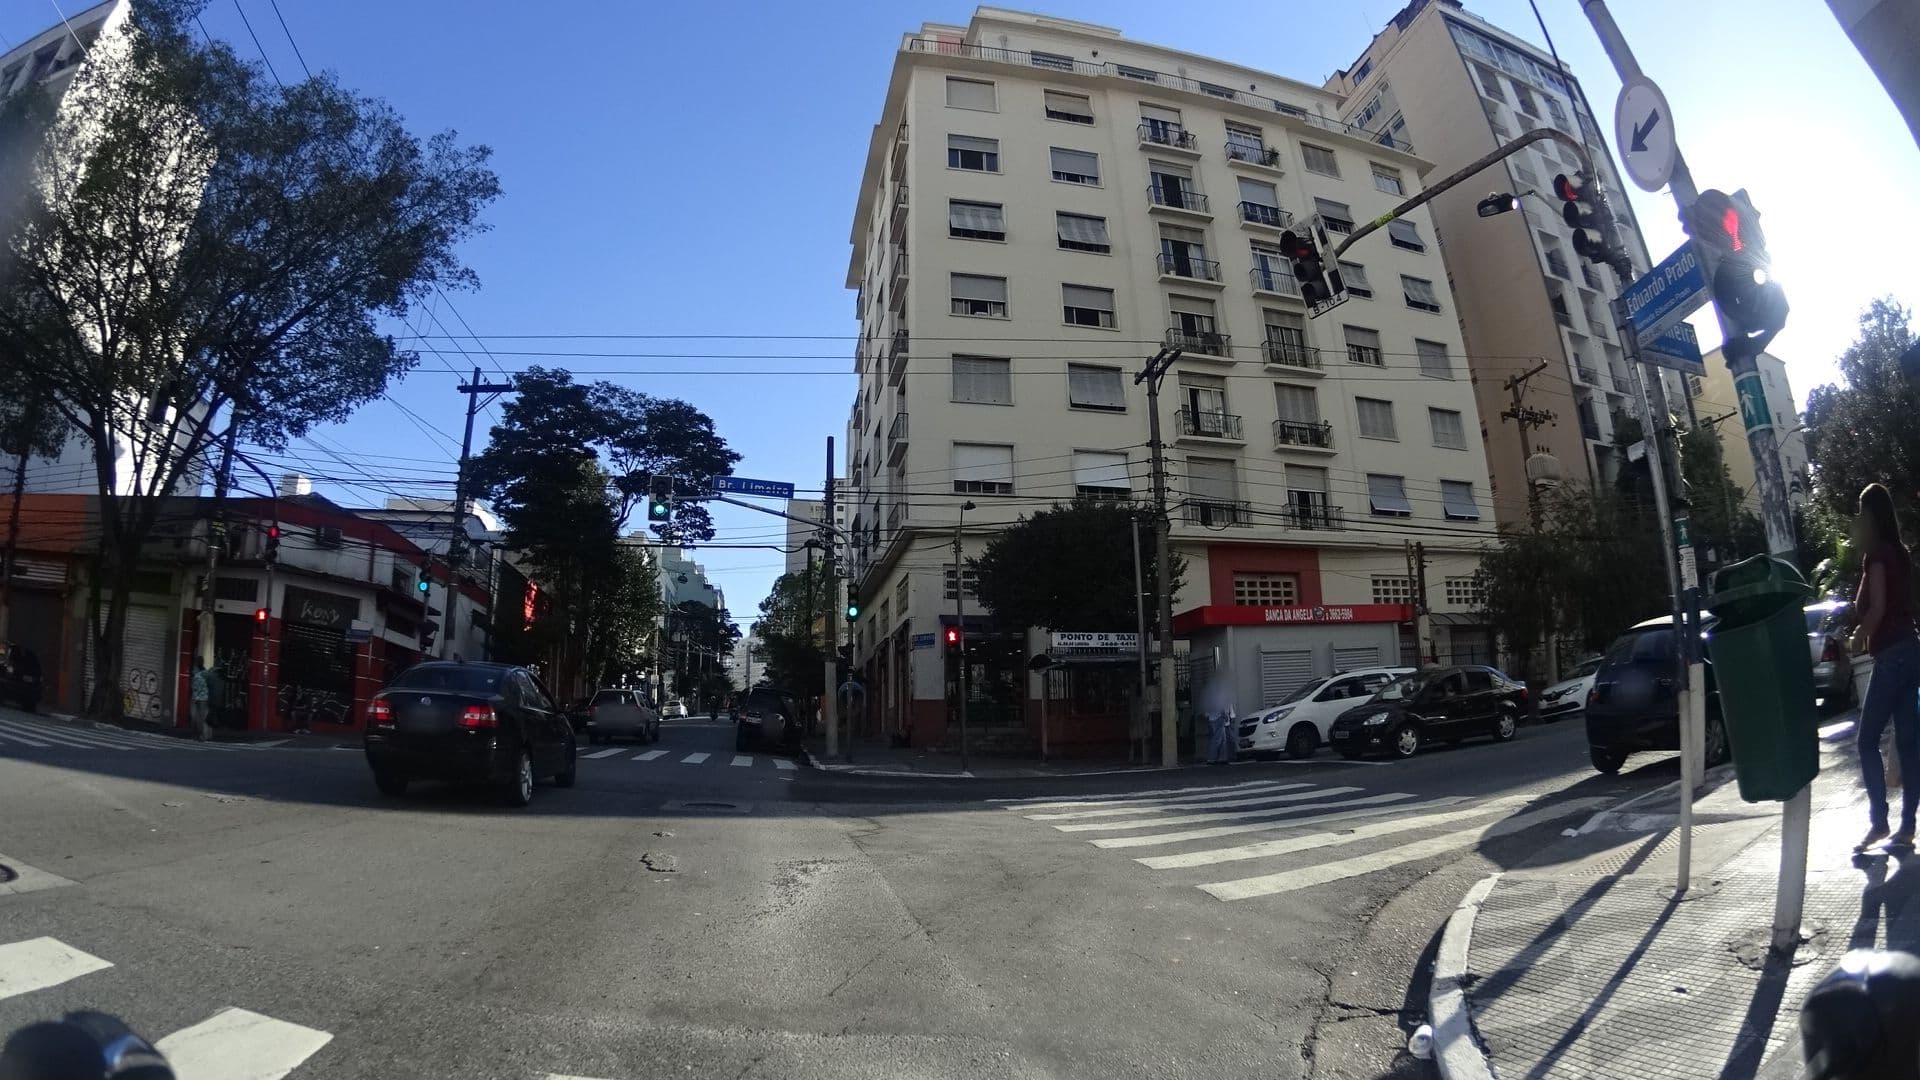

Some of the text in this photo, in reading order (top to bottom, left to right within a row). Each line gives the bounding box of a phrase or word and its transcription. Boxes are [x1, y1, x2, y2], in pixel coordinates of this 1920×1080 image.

[1626, 275, 1666, 314] Eduardo
[1665, 252, 1696, 285] Prado
[1265, 609, 1284, 621] BANCA
[1284, 609, 1292, 621] DA
[1292, 608, 1313, 620] ANGELA
[1060, 633, 1136, 641] PONTO DE TAXI
